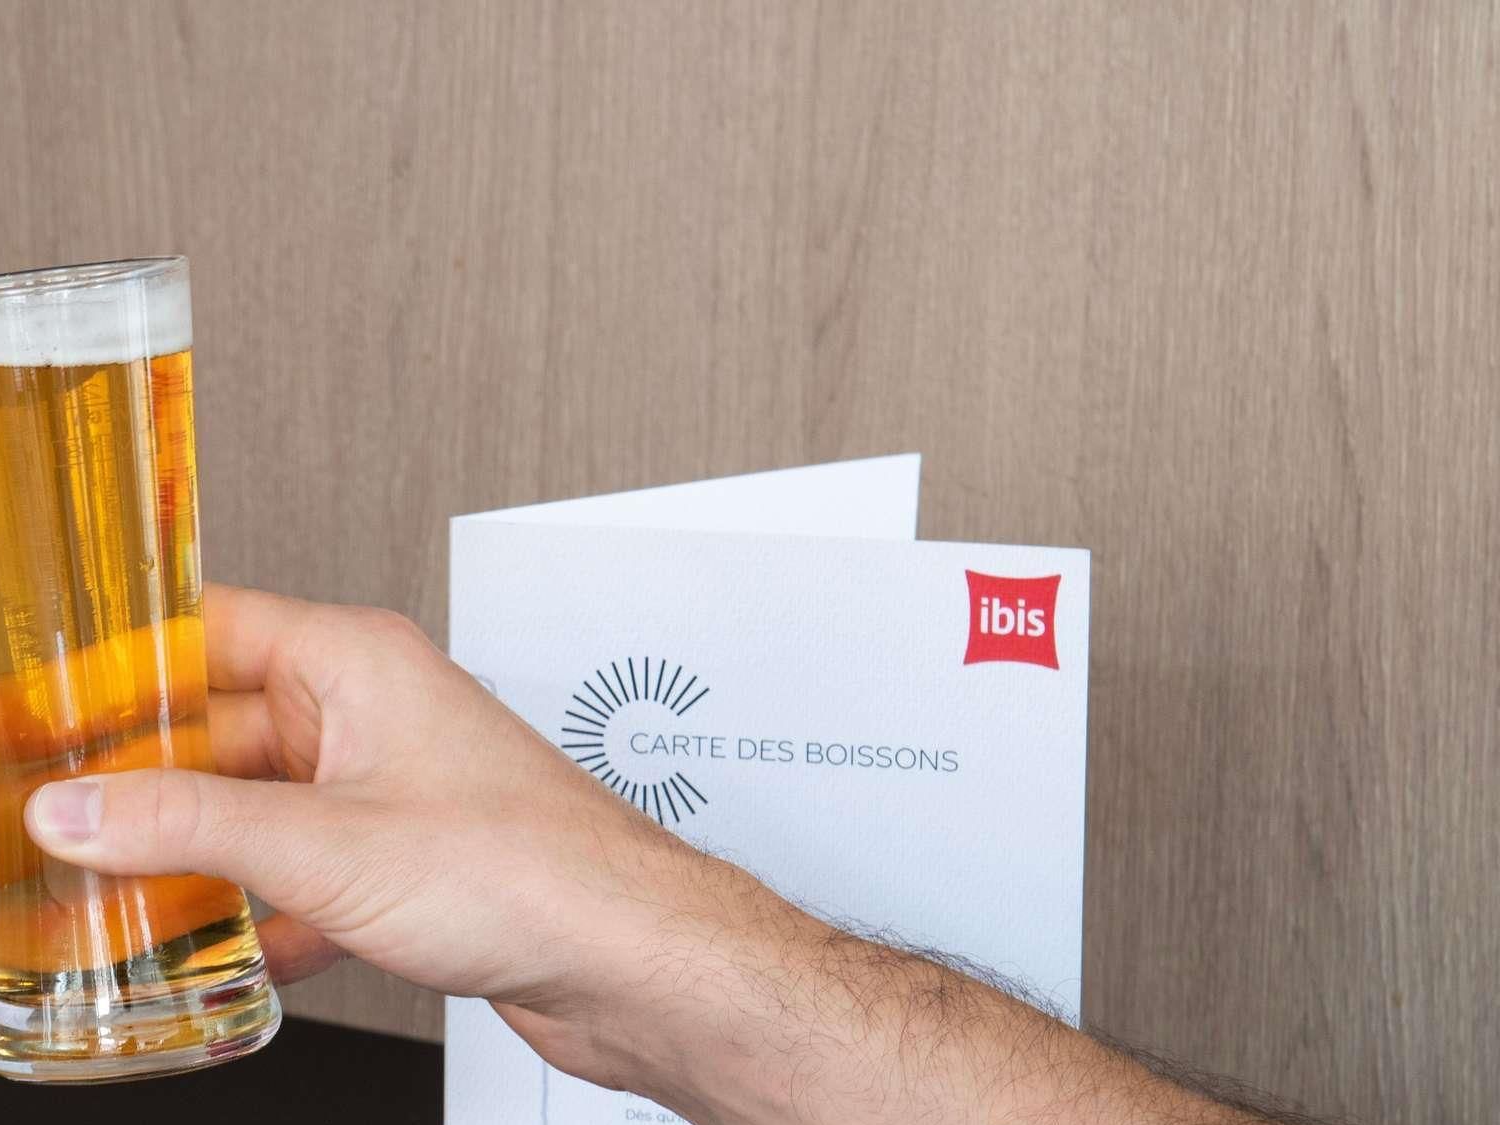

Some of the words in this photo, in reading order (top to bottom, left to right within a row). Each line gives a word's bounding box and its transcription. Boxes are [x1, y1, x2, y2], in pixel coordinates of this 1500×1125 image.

[980, 597, 1046, 637] ibis
[630, 732, 726, 759] CARTE
[737, 737, 794, 762] DES
[806, 741, 959, 773] BOISSONS
